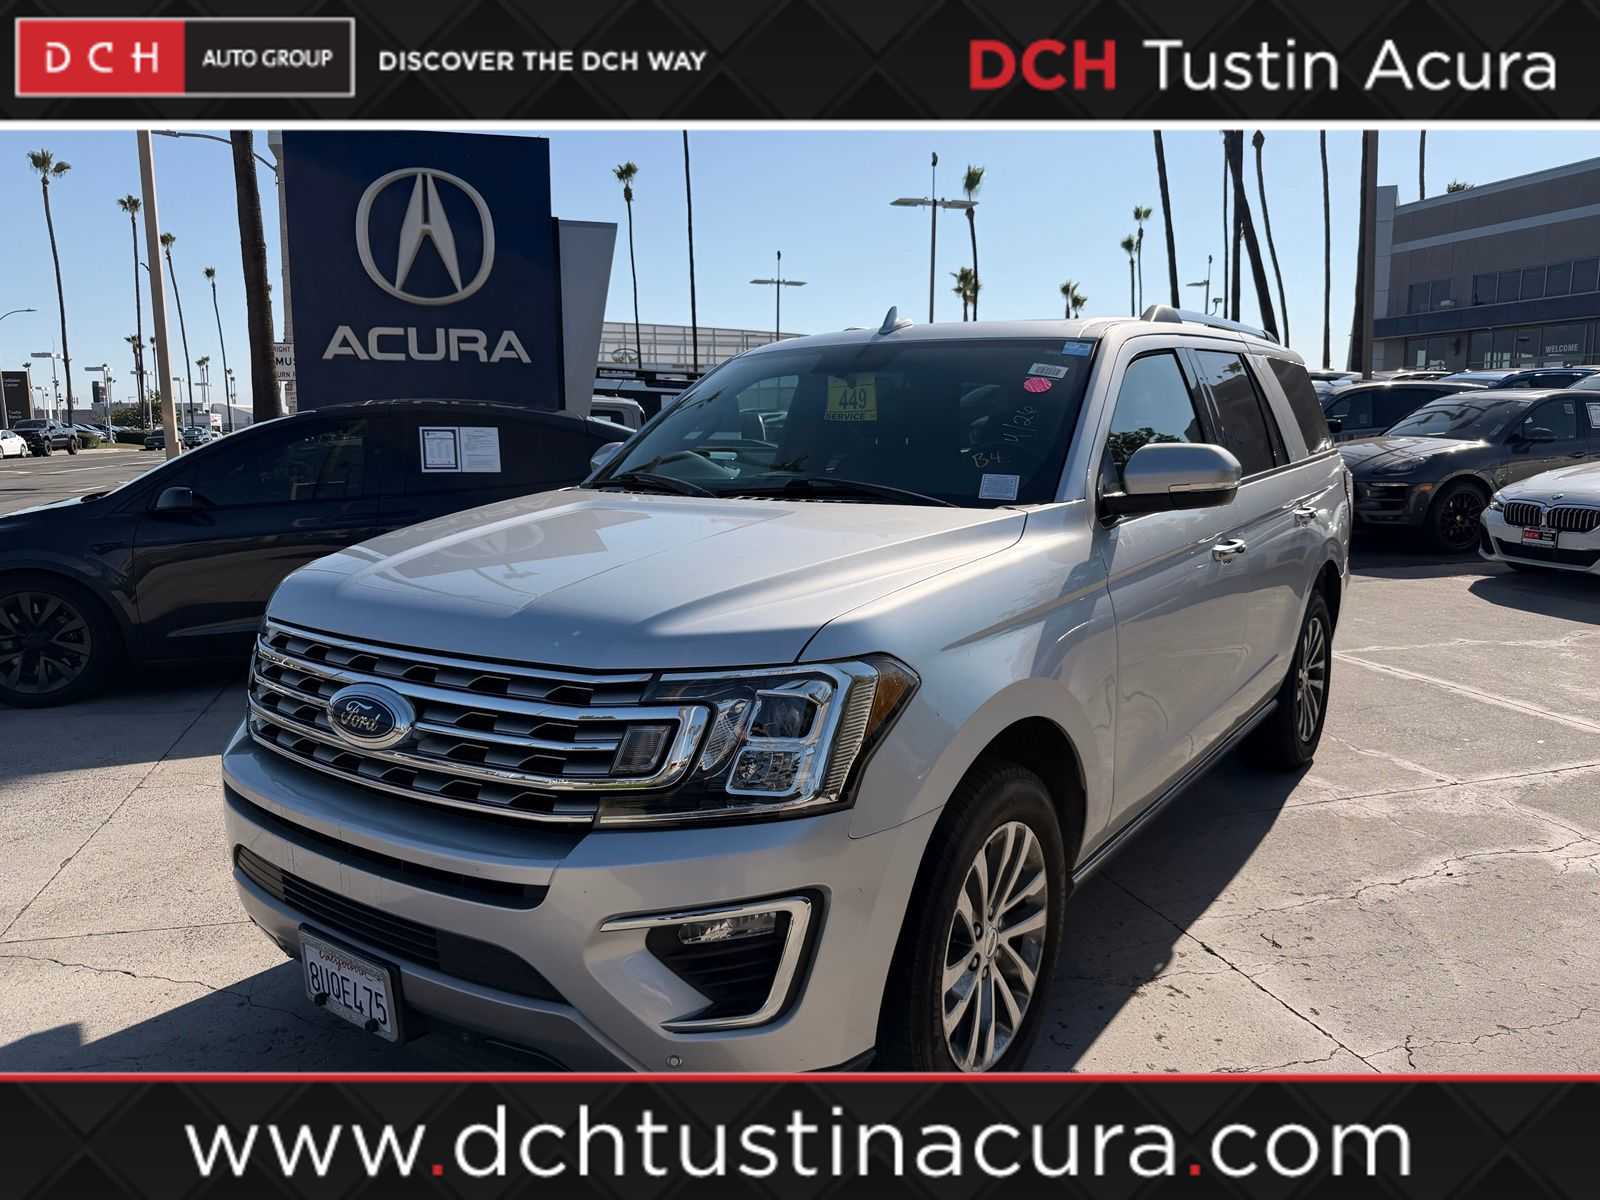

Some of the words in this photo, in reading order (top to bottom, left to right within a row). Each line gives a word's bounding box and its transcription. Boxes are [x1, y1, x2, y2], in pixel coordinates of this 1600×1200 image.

[322, 325, 532, 363] ACURA
[1545, 344, 1578, 352] WELCOME
[838, 387, 867, 409] 449
[340, 700, 381, 731] Ford
